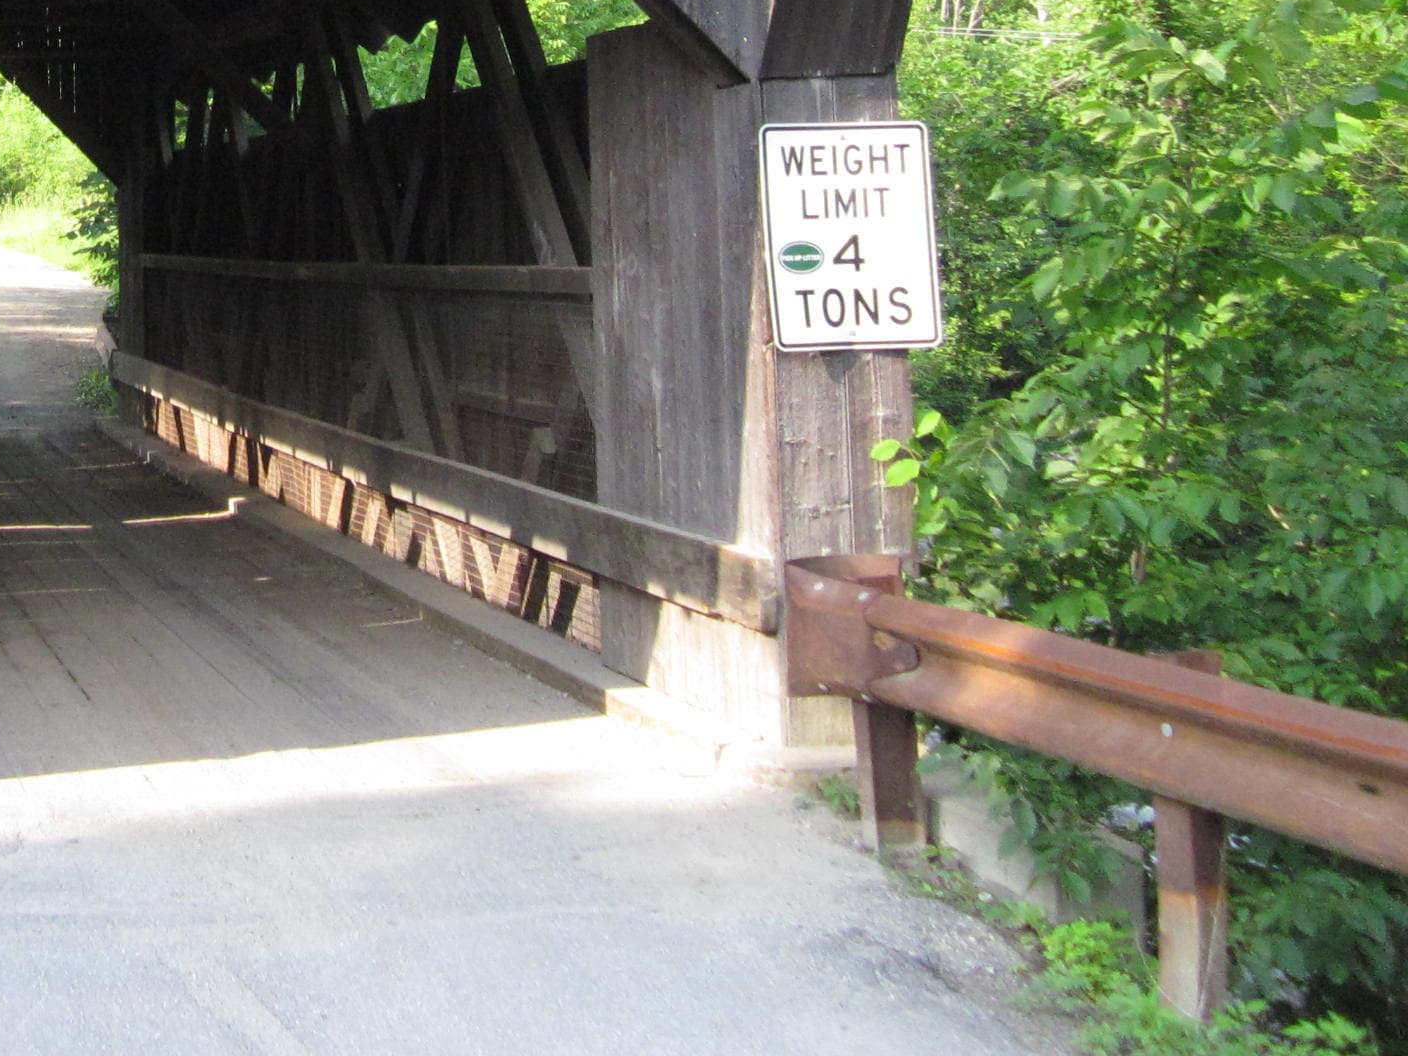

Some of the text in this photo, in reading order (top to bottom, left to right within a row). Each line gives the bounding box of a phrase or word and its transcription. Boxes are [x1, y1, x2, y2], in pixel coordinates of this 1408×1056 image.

[781, 144, 910, 176] WEIGHT
[801, 187, 890, 219] LIMIT
[832, 234, 865, 272] 4
[794, 287, 913, 328] TONS
